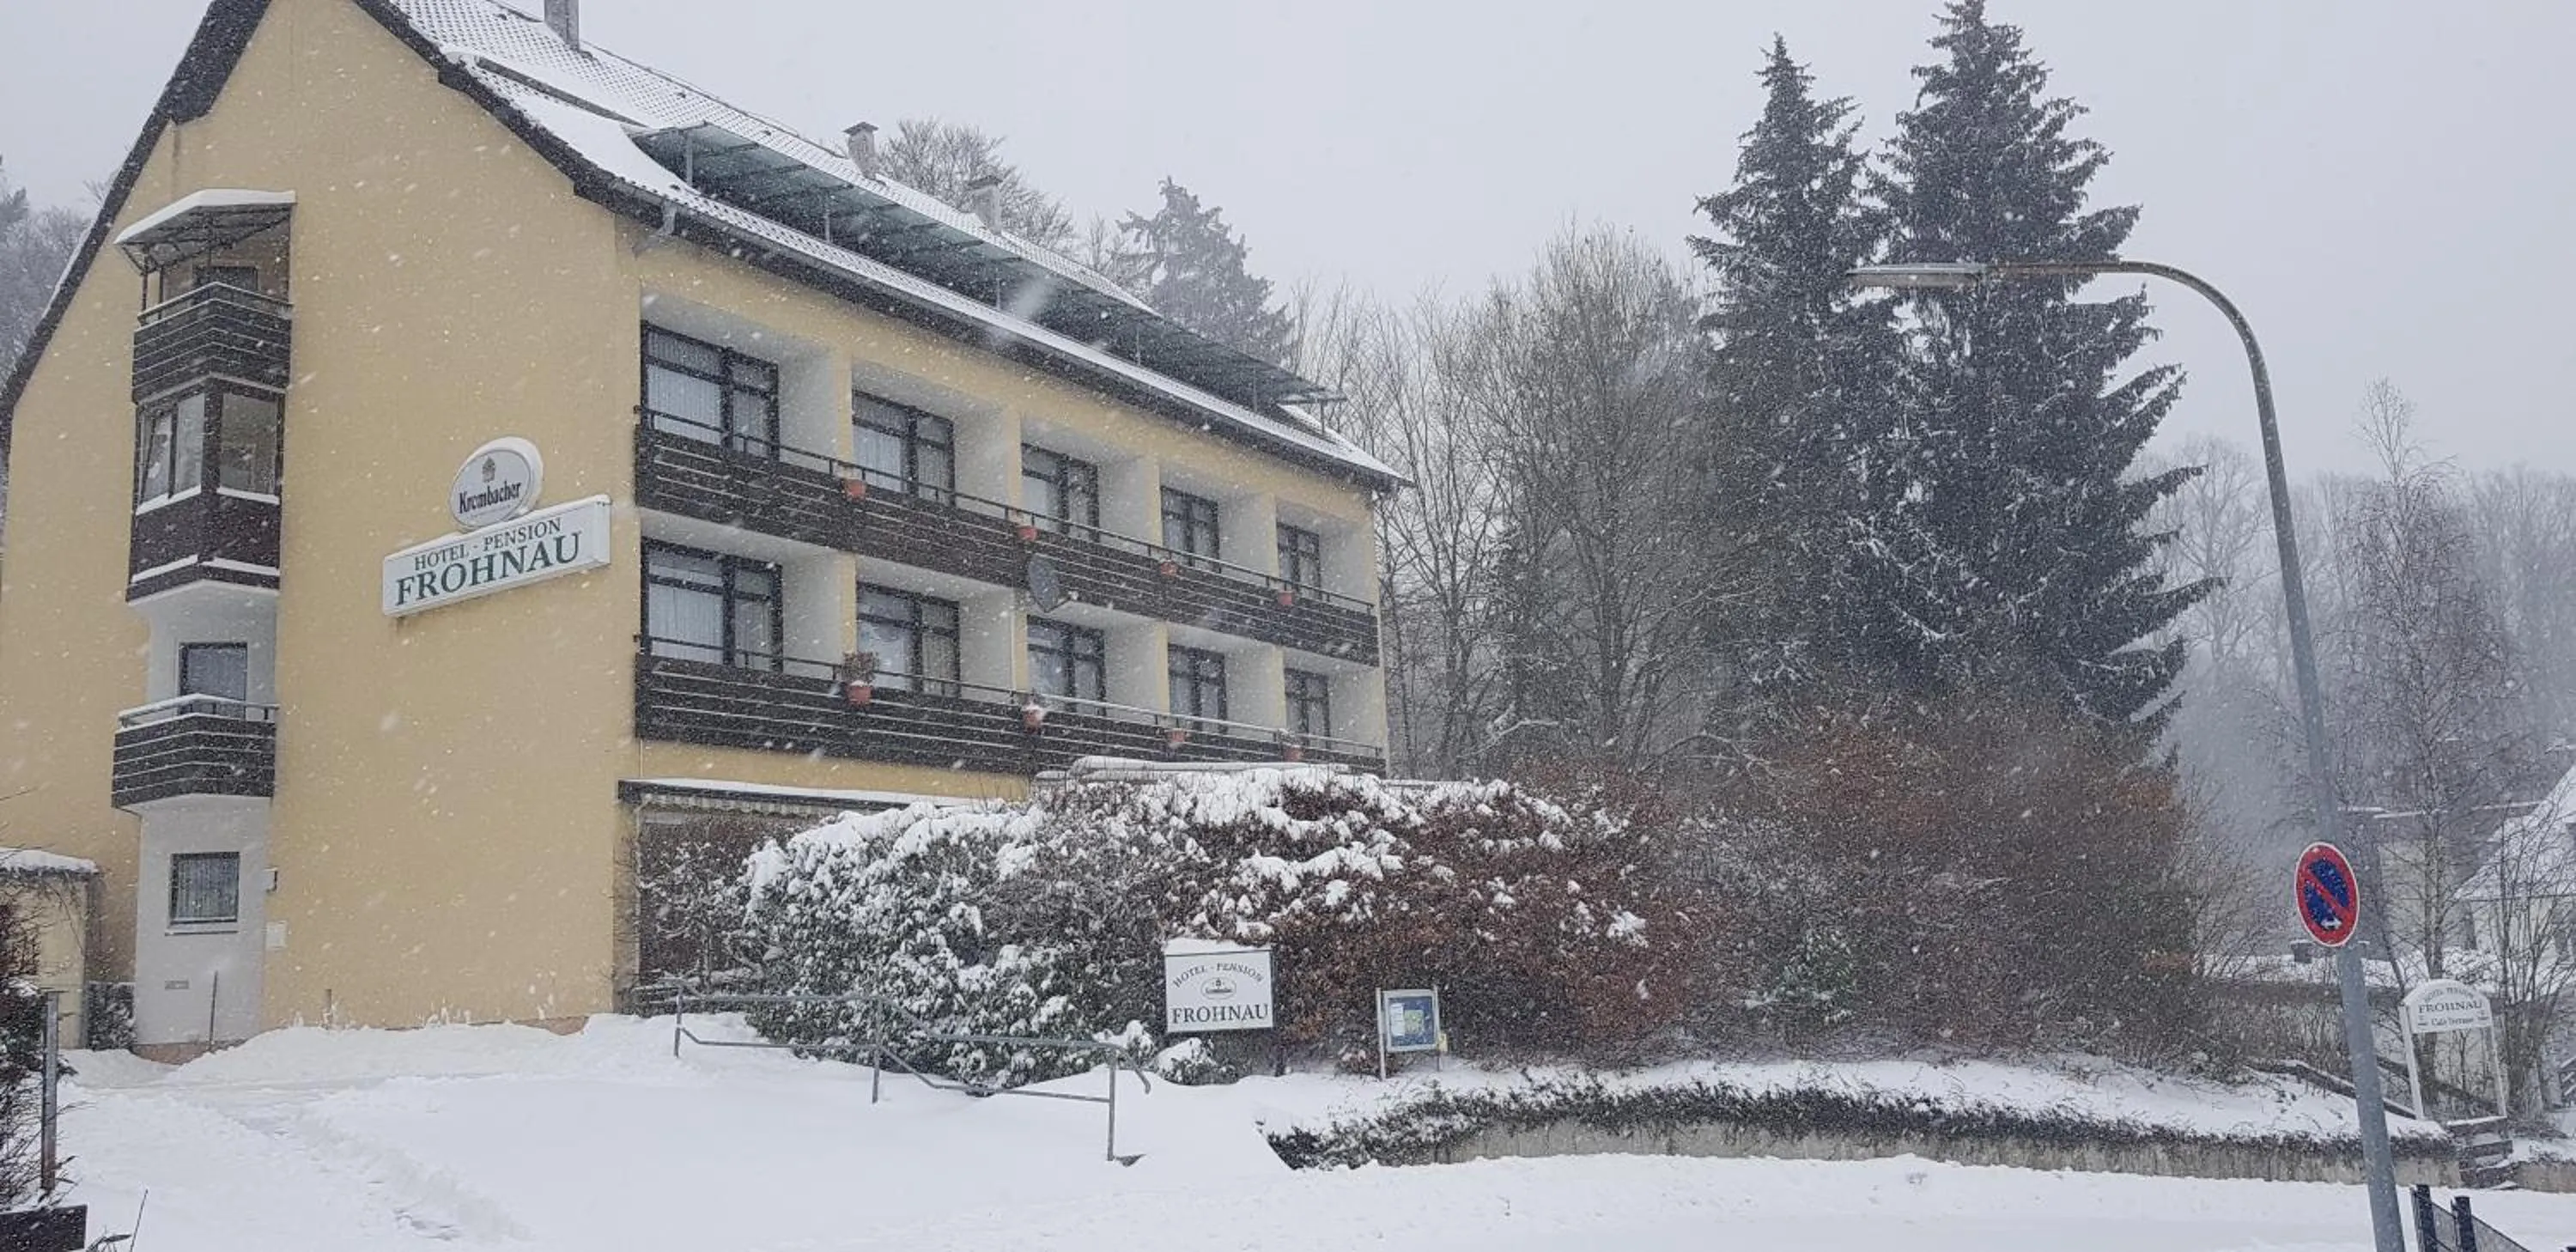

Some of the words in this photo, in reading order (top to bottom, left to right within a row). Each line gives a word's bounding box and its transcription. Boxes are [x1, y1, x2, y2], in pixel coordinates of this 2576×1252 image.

[459, 479, 522, 514] Krombacher
[414, 544, 470, 572] HOTEL
[483, 517, 562, 552] PENSION
[395, 530, 583, 606] FROHNAU
[1172, 963, 1207, 989] HOTEL
[1216, 962, 1265, 982] PENSION
[1170, 1002, 1269, 1024] FROHNAU
[2417, 998, 2483, 1014] FROHNAU
